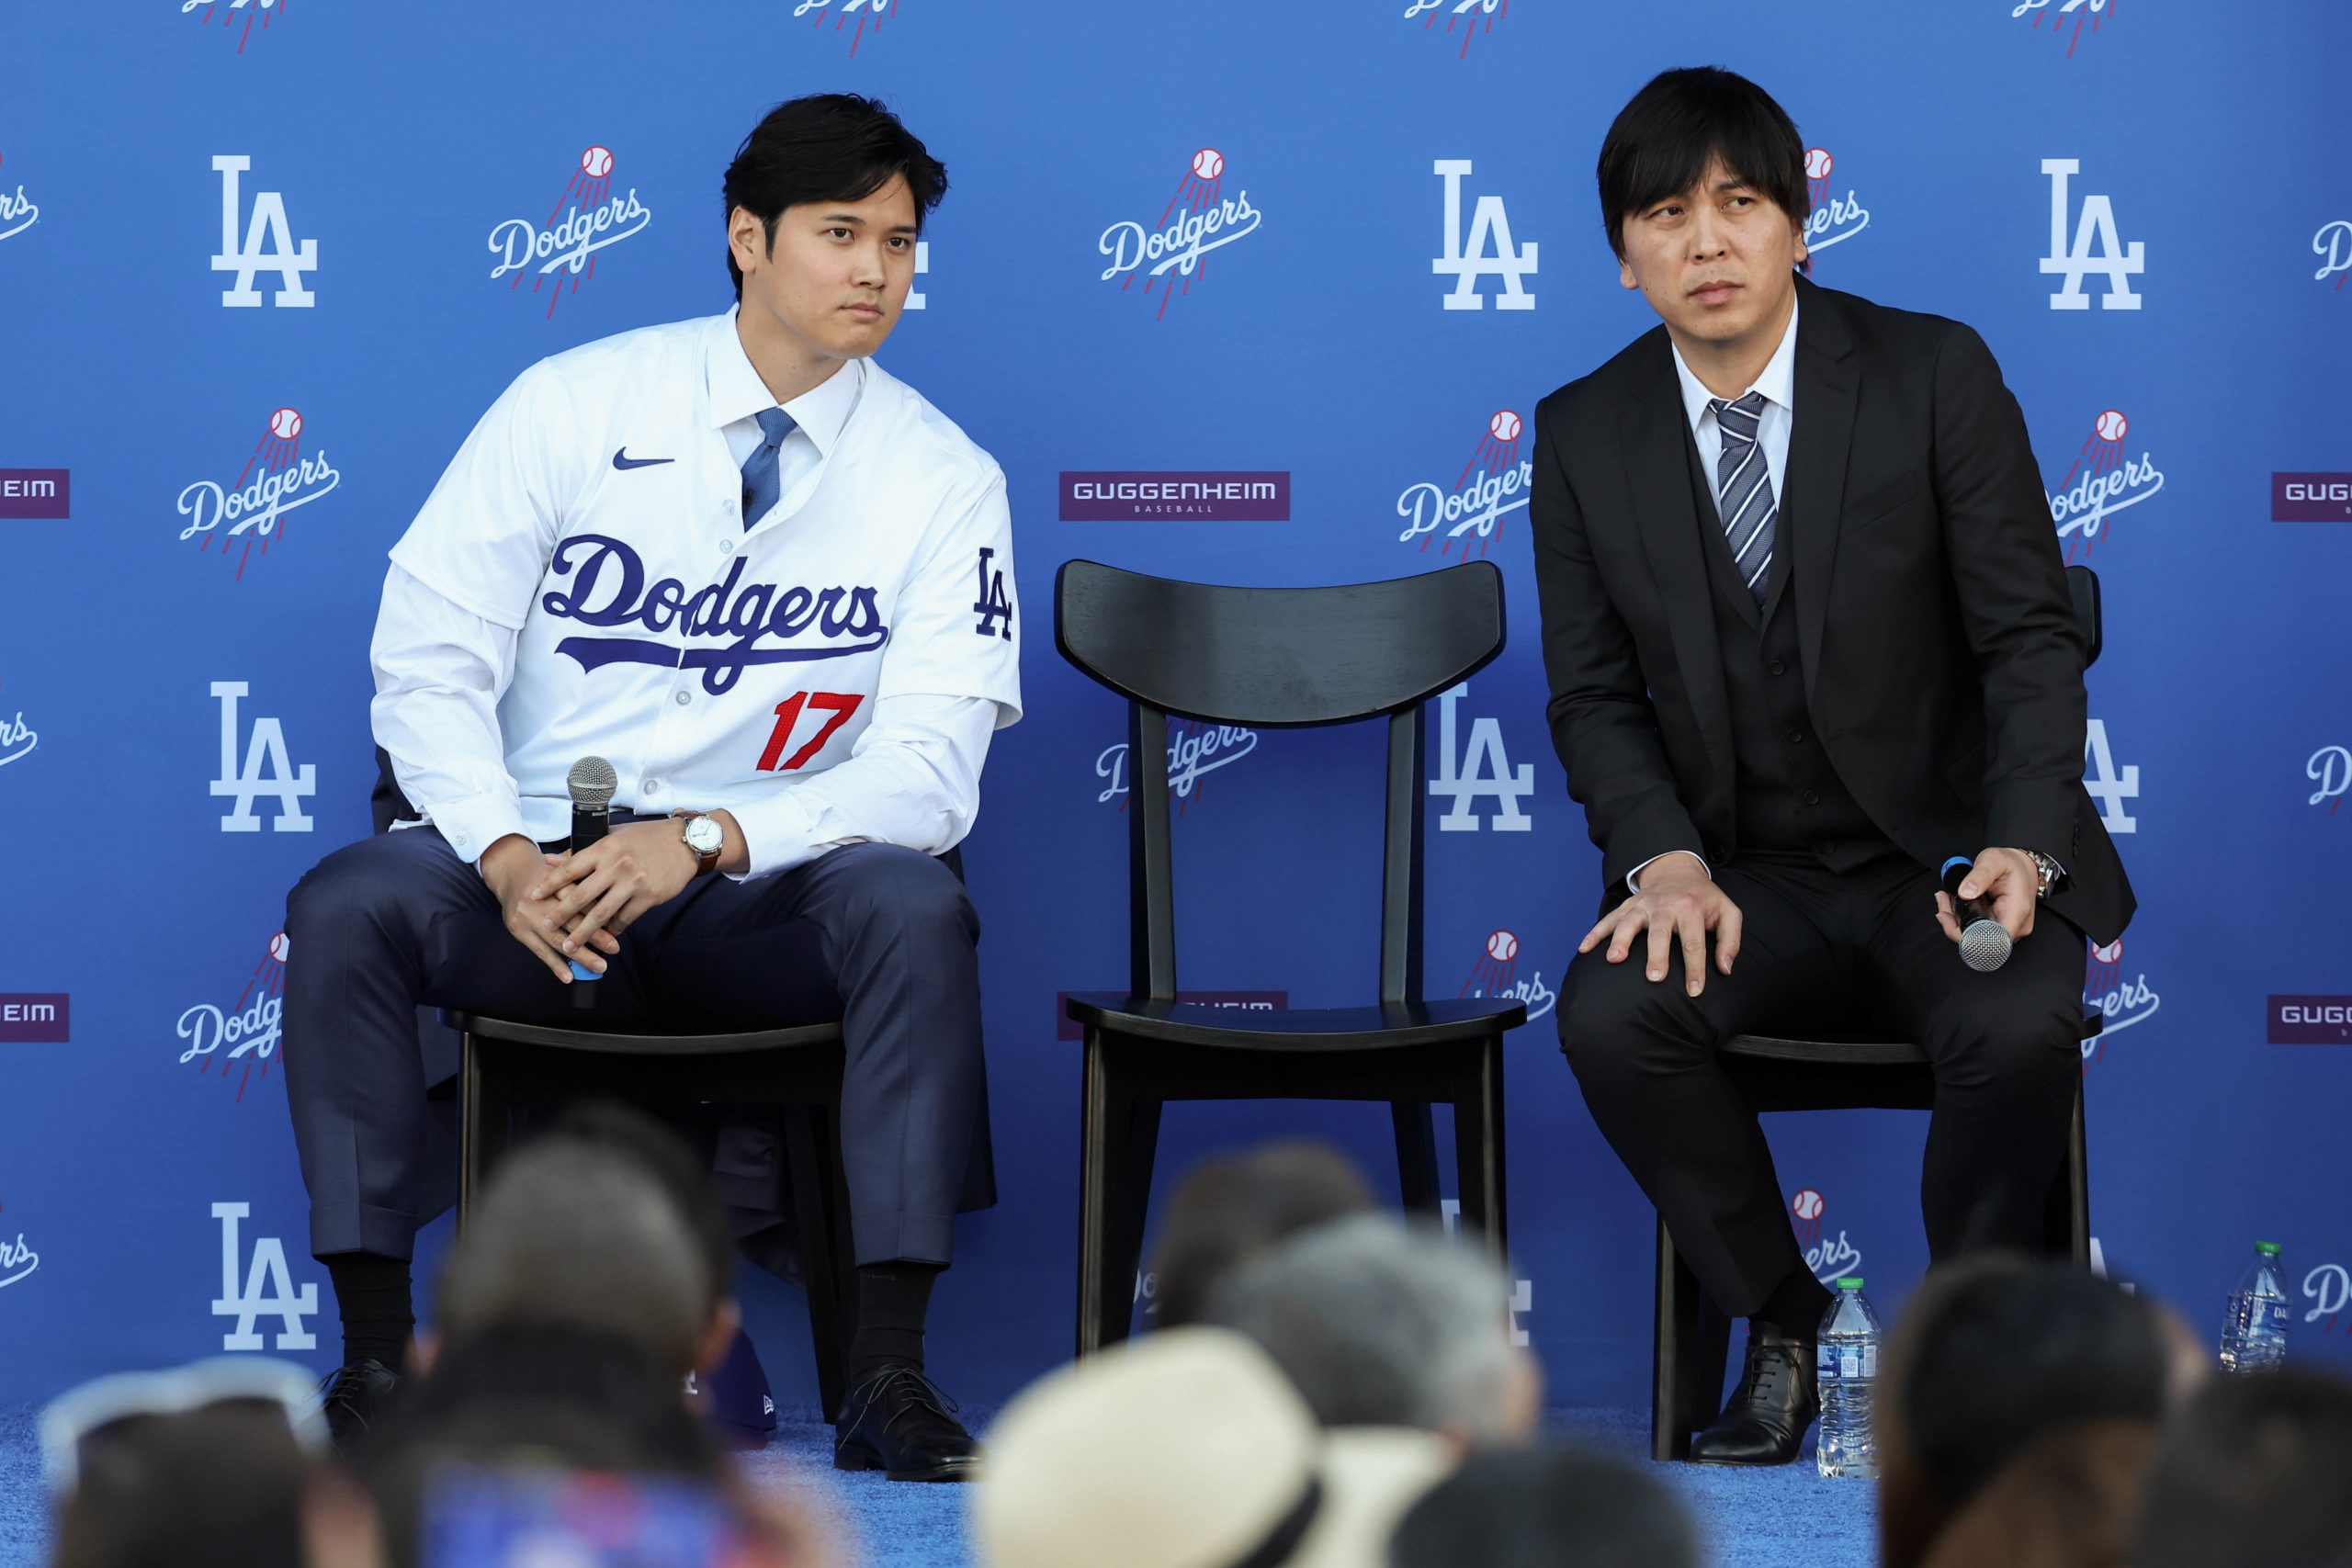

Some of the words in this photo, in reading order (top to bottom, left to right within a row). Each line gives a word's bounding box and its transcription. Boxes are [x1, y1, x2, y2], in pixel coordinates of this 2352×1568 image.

[211, 155, 318, 308] LA
[488, 188, 651, 279] Dodgers
[1099, 190, 1261, 281] Dodgers
[1432, 160, 1539, 310] LA
[2040, 159, 2145, 310] LA
[177, 450, 340, 541] Dodgers
[1074, 483, 1275, 500] GUGGENHEIM
[1135, 505, 1213, 513] BASEBALL
[1396, 460, 1532, 543] Dodger
[2045, 452, 2165, 538] odgers
[542, 534, 888, 696] Dodgers
[973, 547, 1012, 642] LA
[210, 681, 317, 832] LA
[755, 691, 865, 771] 17
[1095, 725, 1258, 803] Ddgers
[1429, 682, 1535, 832] LA
[2082, 718, 2140, 833] A
[176, 991, 282, 1064] Dodg
[211, 1201, 318, 1351] LA
